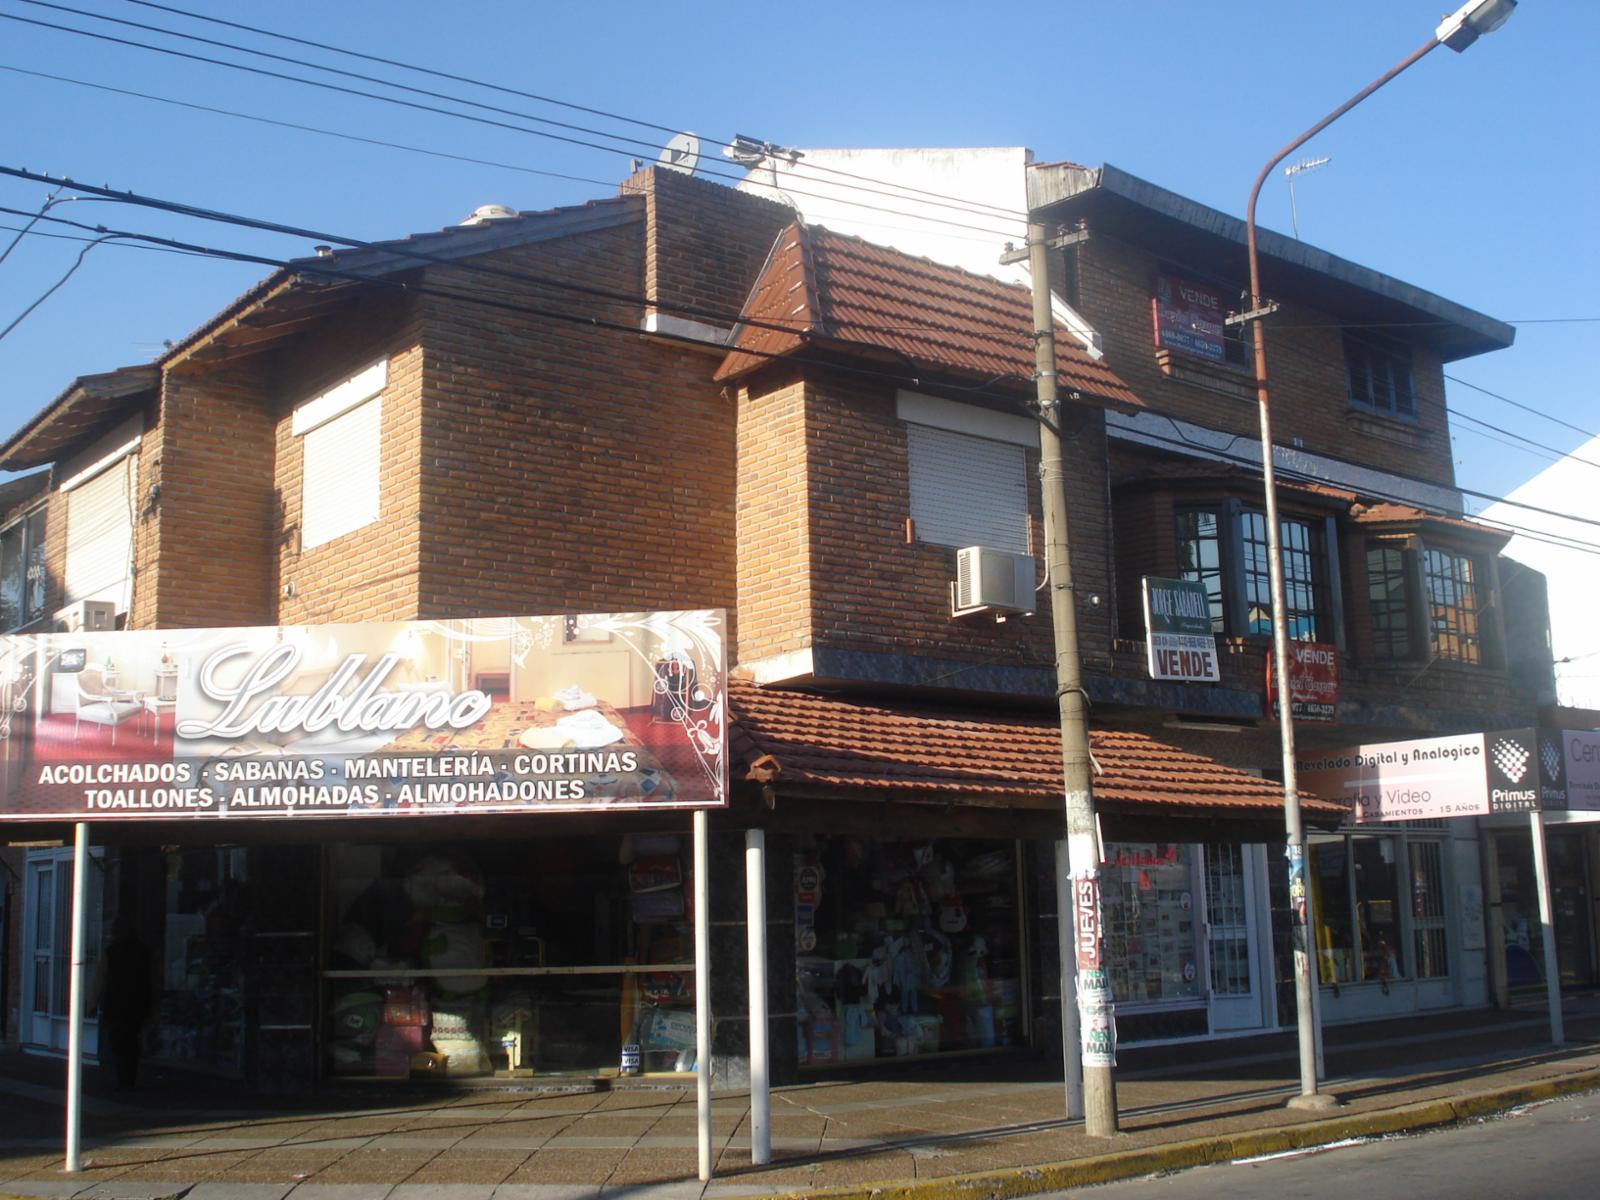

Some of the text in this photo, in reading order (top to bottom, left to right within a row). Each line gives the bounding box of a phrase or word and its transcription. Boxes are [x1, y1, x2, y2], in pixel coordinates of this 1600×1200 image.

[1179, 287, 1218, 309] VENDE
[1157, 649, 1213, 677] VENDE
[1296, 649, 1334, 665] VENDE
[38, 751, 637, 784] ACOLCHADOS SABANAS MANTELERÍA CORTINAS
[1355, 750, 1397, 768] Digital
[1402, 753, 1408, 766] y
[84, 780, 585, 808] TOALLONES ALMOHADAS ALMOHADONES
[1376, 794, 1382, 810] y
[1386, 789, 1431, 804] Video
[1492, 788, 1536, 802] Primus
[1440, 805, 1451, 813] 15
[1455, 802, 1480, 812] AÑOS
[1493, 801, 1536, 810] DIGITAL
[1079, 881, 1096, 959] JUEVES
[623, 1057, 639, 1065] VISA
